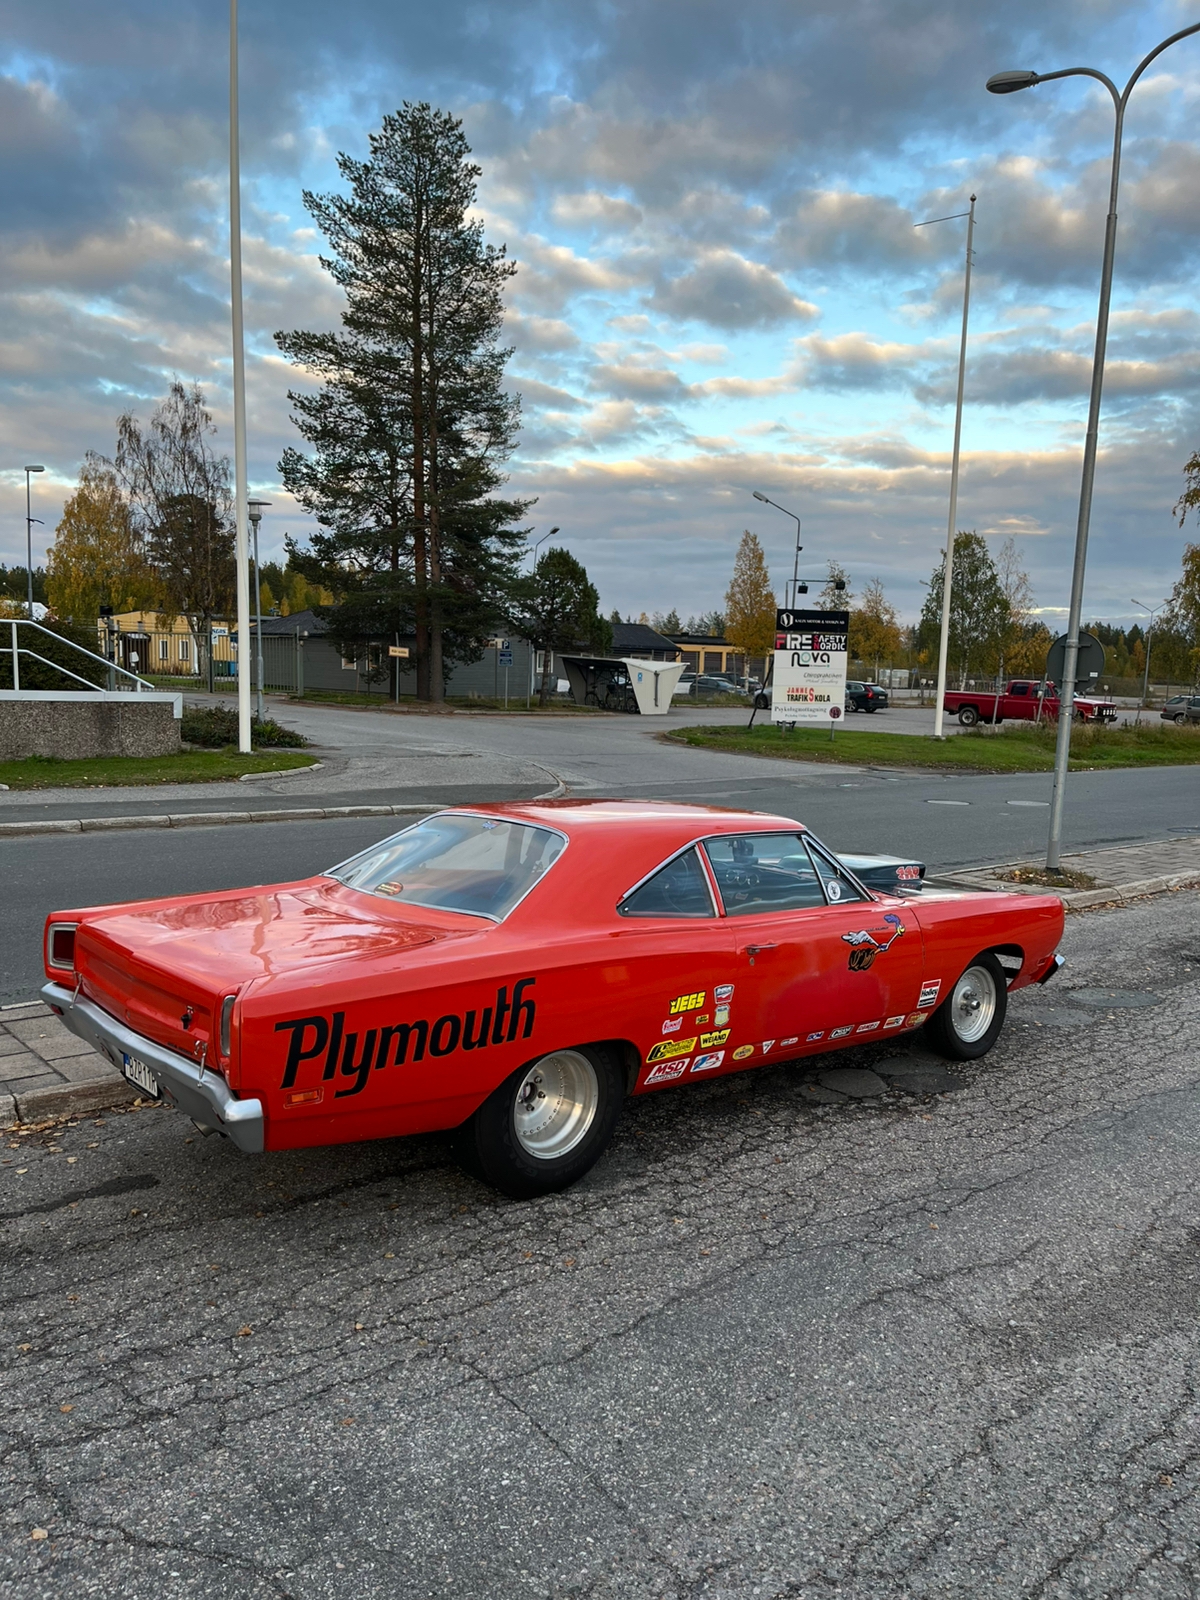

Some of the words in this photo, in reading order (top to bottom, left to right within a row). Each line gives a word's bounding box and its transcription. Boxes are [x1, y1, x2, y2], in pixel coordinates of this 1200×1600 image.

[776, 634, 812, 650] FIRE
[814, 635, 846, 643] SAFETY
[814, 642, 845, 650] NORDIC
[921, 988, 939, 997] Holley
[670, 991, 706, 1014] JEGS
[274, 977, 536, 1098] Plymouth
[702, 1033, 727, 1045] WEIAND
[653, 1060, 686, 1076] MSD
